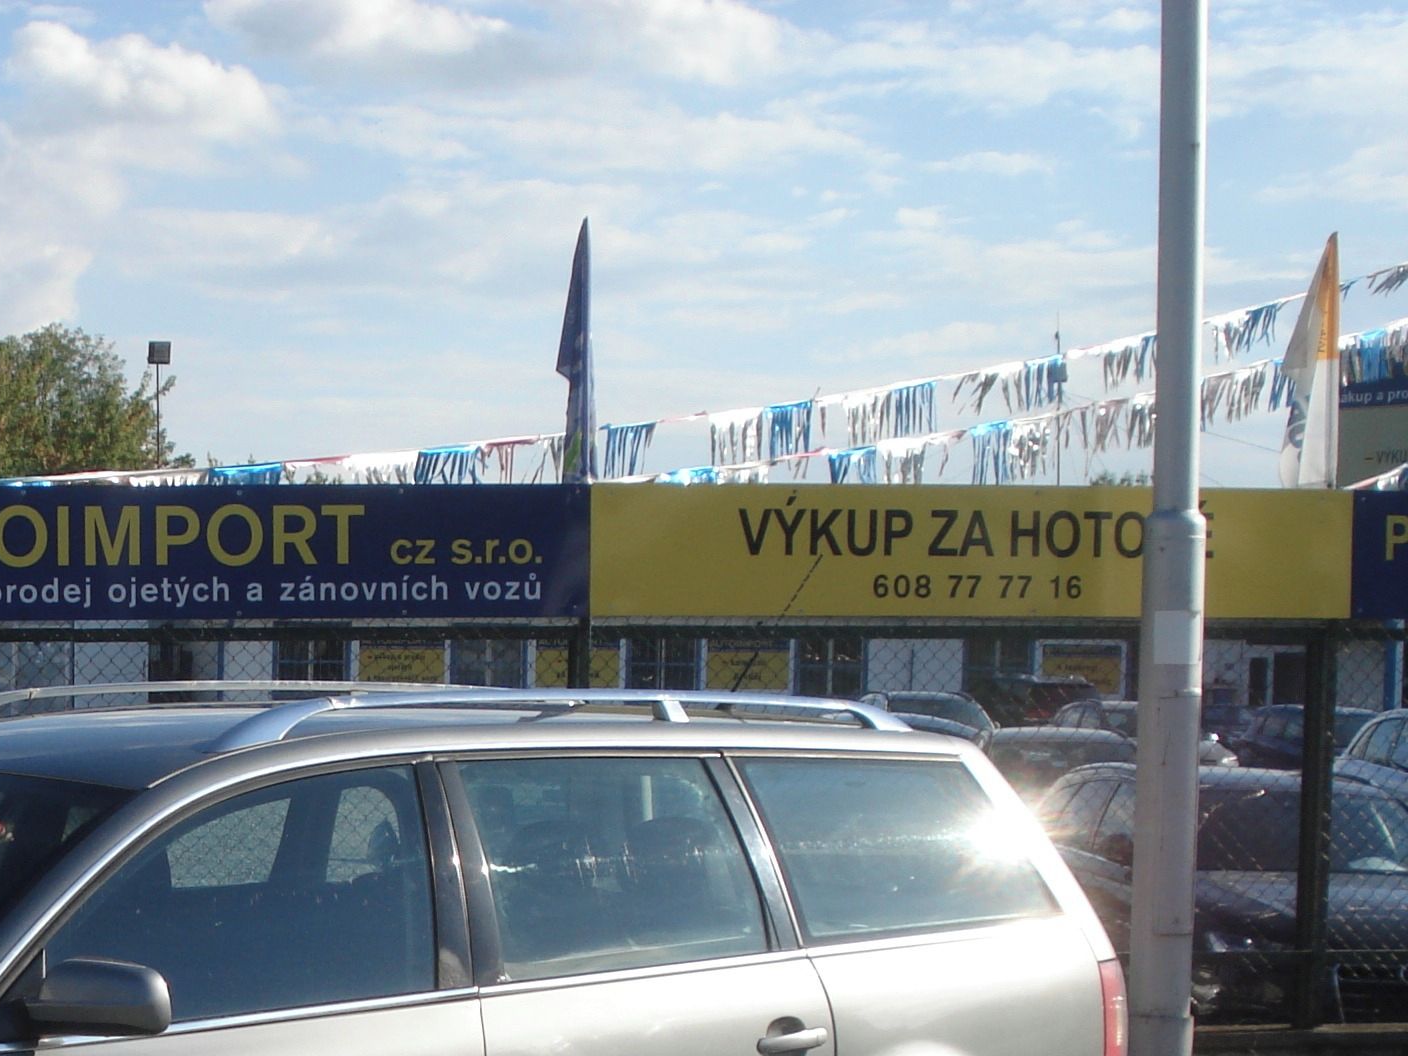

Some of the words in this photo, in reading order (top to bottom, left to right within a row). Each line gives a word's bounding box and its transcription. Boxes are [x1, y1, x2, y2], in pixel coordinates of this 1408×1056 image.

[739, 496, 914, 558] VÝKUP
[927, 509, 994, 558] ZA
[1010, 500, 1214, 559] HOTO
[391, 538, 435, 565] cz
[451, 538, 543, 565] s.r.o.
[108, 577, 231, 608] ojetých
[246, 583, 265, 603] a
[279, 574, 449, 602] zánovních
[464, 571, 542, 601] vozů
[872, 574, 932, 599] 608
[947, 574, 982, 599] 77
[999, 574, 1032, 599] 77
[1050, 574, 1082, 600] 16
